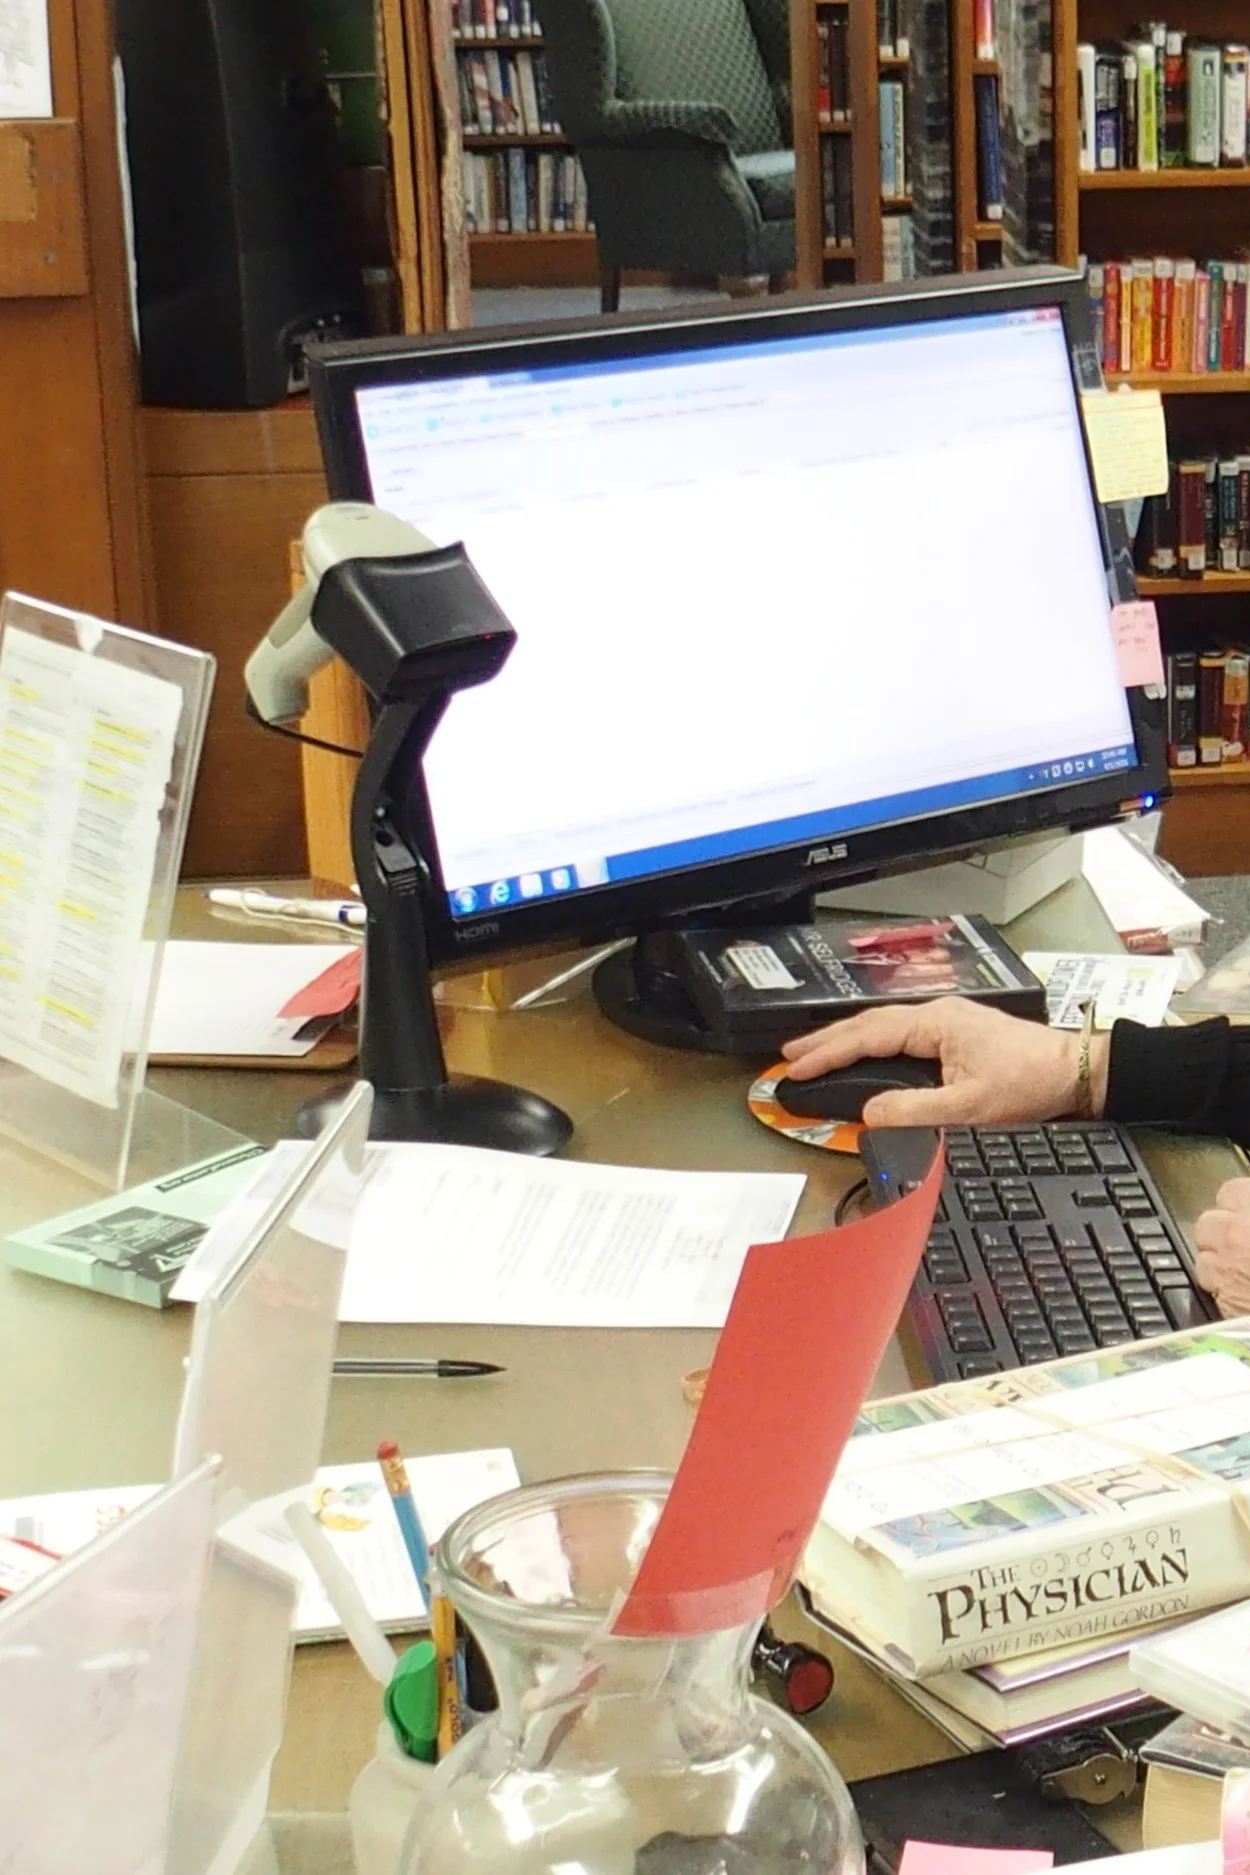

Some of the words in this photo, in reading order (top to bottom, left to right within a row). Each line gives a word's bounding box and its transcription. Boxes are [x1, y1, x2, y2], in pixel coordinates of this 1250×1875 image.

[805, 843, 849, 866] ASUS
[927, 1548, 1190, 1645] PHYSICIAN
[970, 1564, 1020, 1591] THE
[958, 1636, 1021, 1667] NOVEL
[1026, 1631, 1052, 1649] BY
[1053, 1615, 1109, 1642] NOAH
[1111, 1595, 1191, 1628] GORDON
